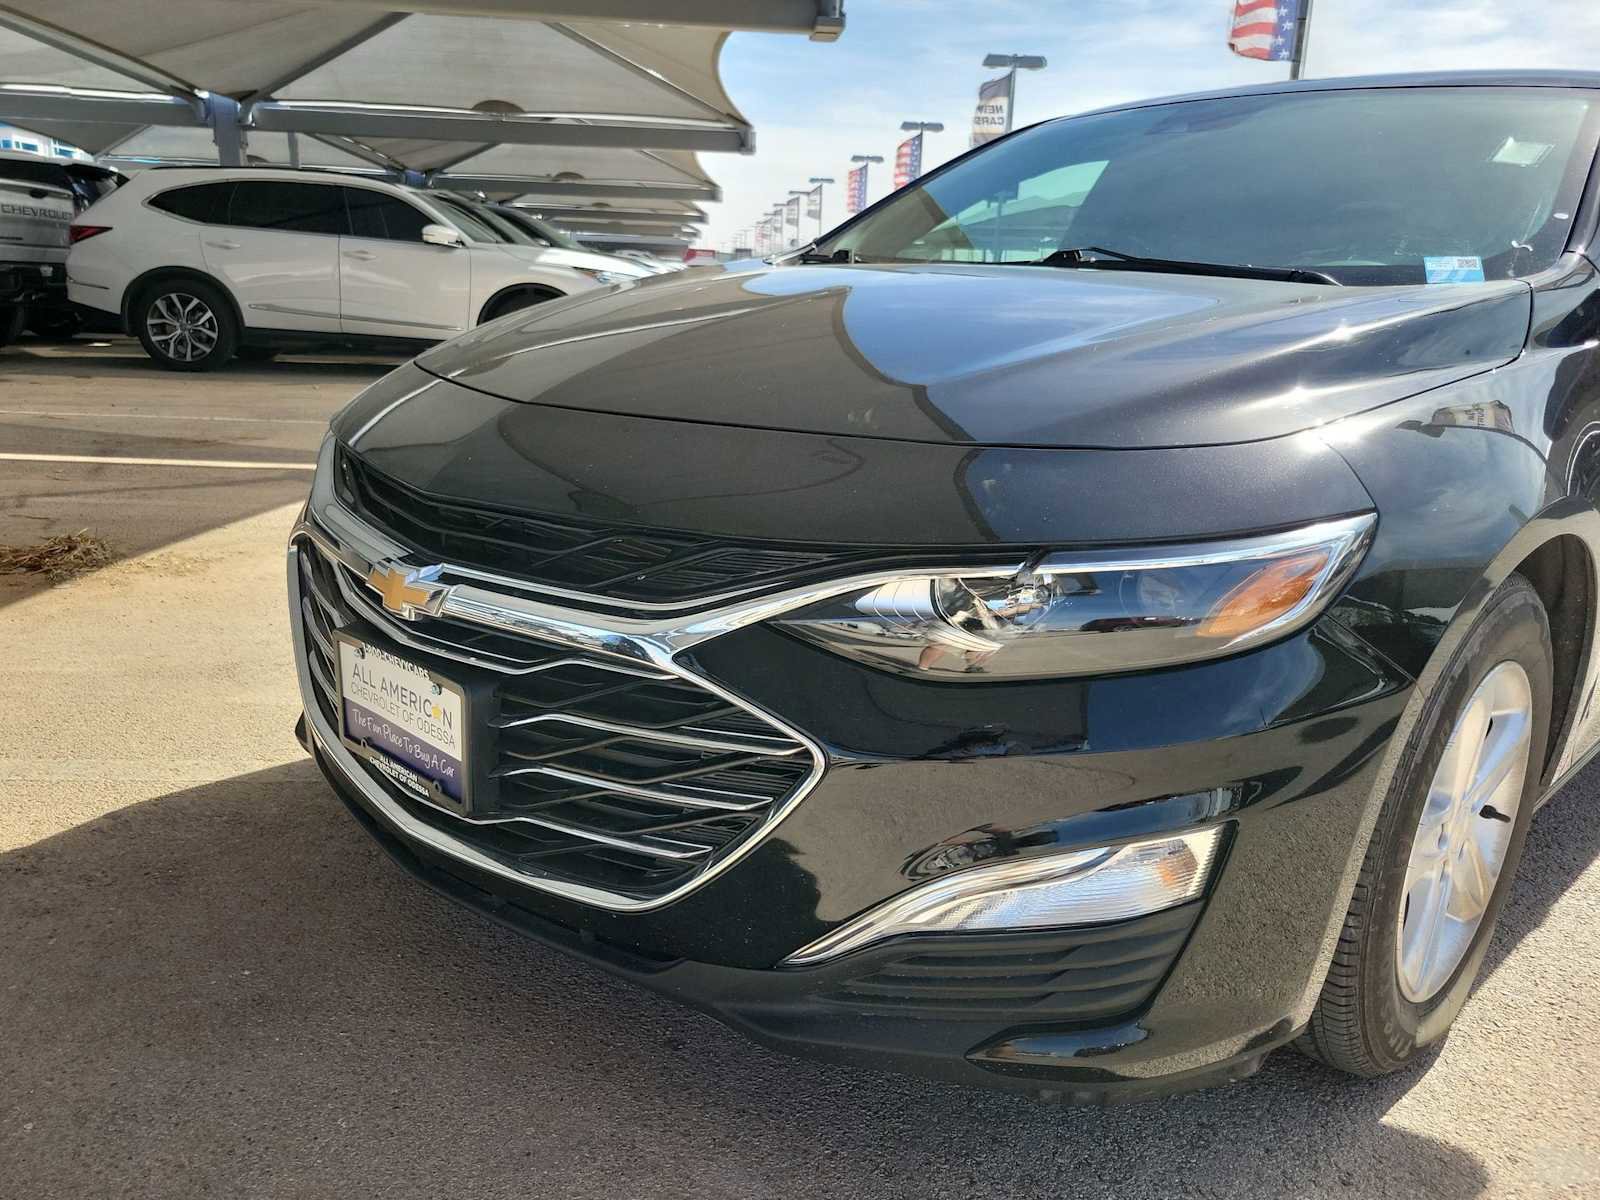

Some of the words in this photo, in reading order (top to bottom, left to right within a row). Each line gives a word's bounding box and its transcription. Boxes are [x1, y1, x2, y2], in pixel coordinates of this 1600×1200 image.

[1, 203, 73, 220] CHEVROLET
[350, 681, 400, 717] CHEVROLET
[403, 709, 415, 726] OF
[417, 717, 456, 750] ODESSA
[353, 663, 376, 689] ALL
[380, 676, 453, 731] AMERICN
[352, 708, 367, 728] The
[383, 723, 403, 748] Place
[403, 736, 413, 754] To
[414, 744, 430, 769] Buy
[431, 754, 441, 770] A
[441, 759, 455, 778] Car
